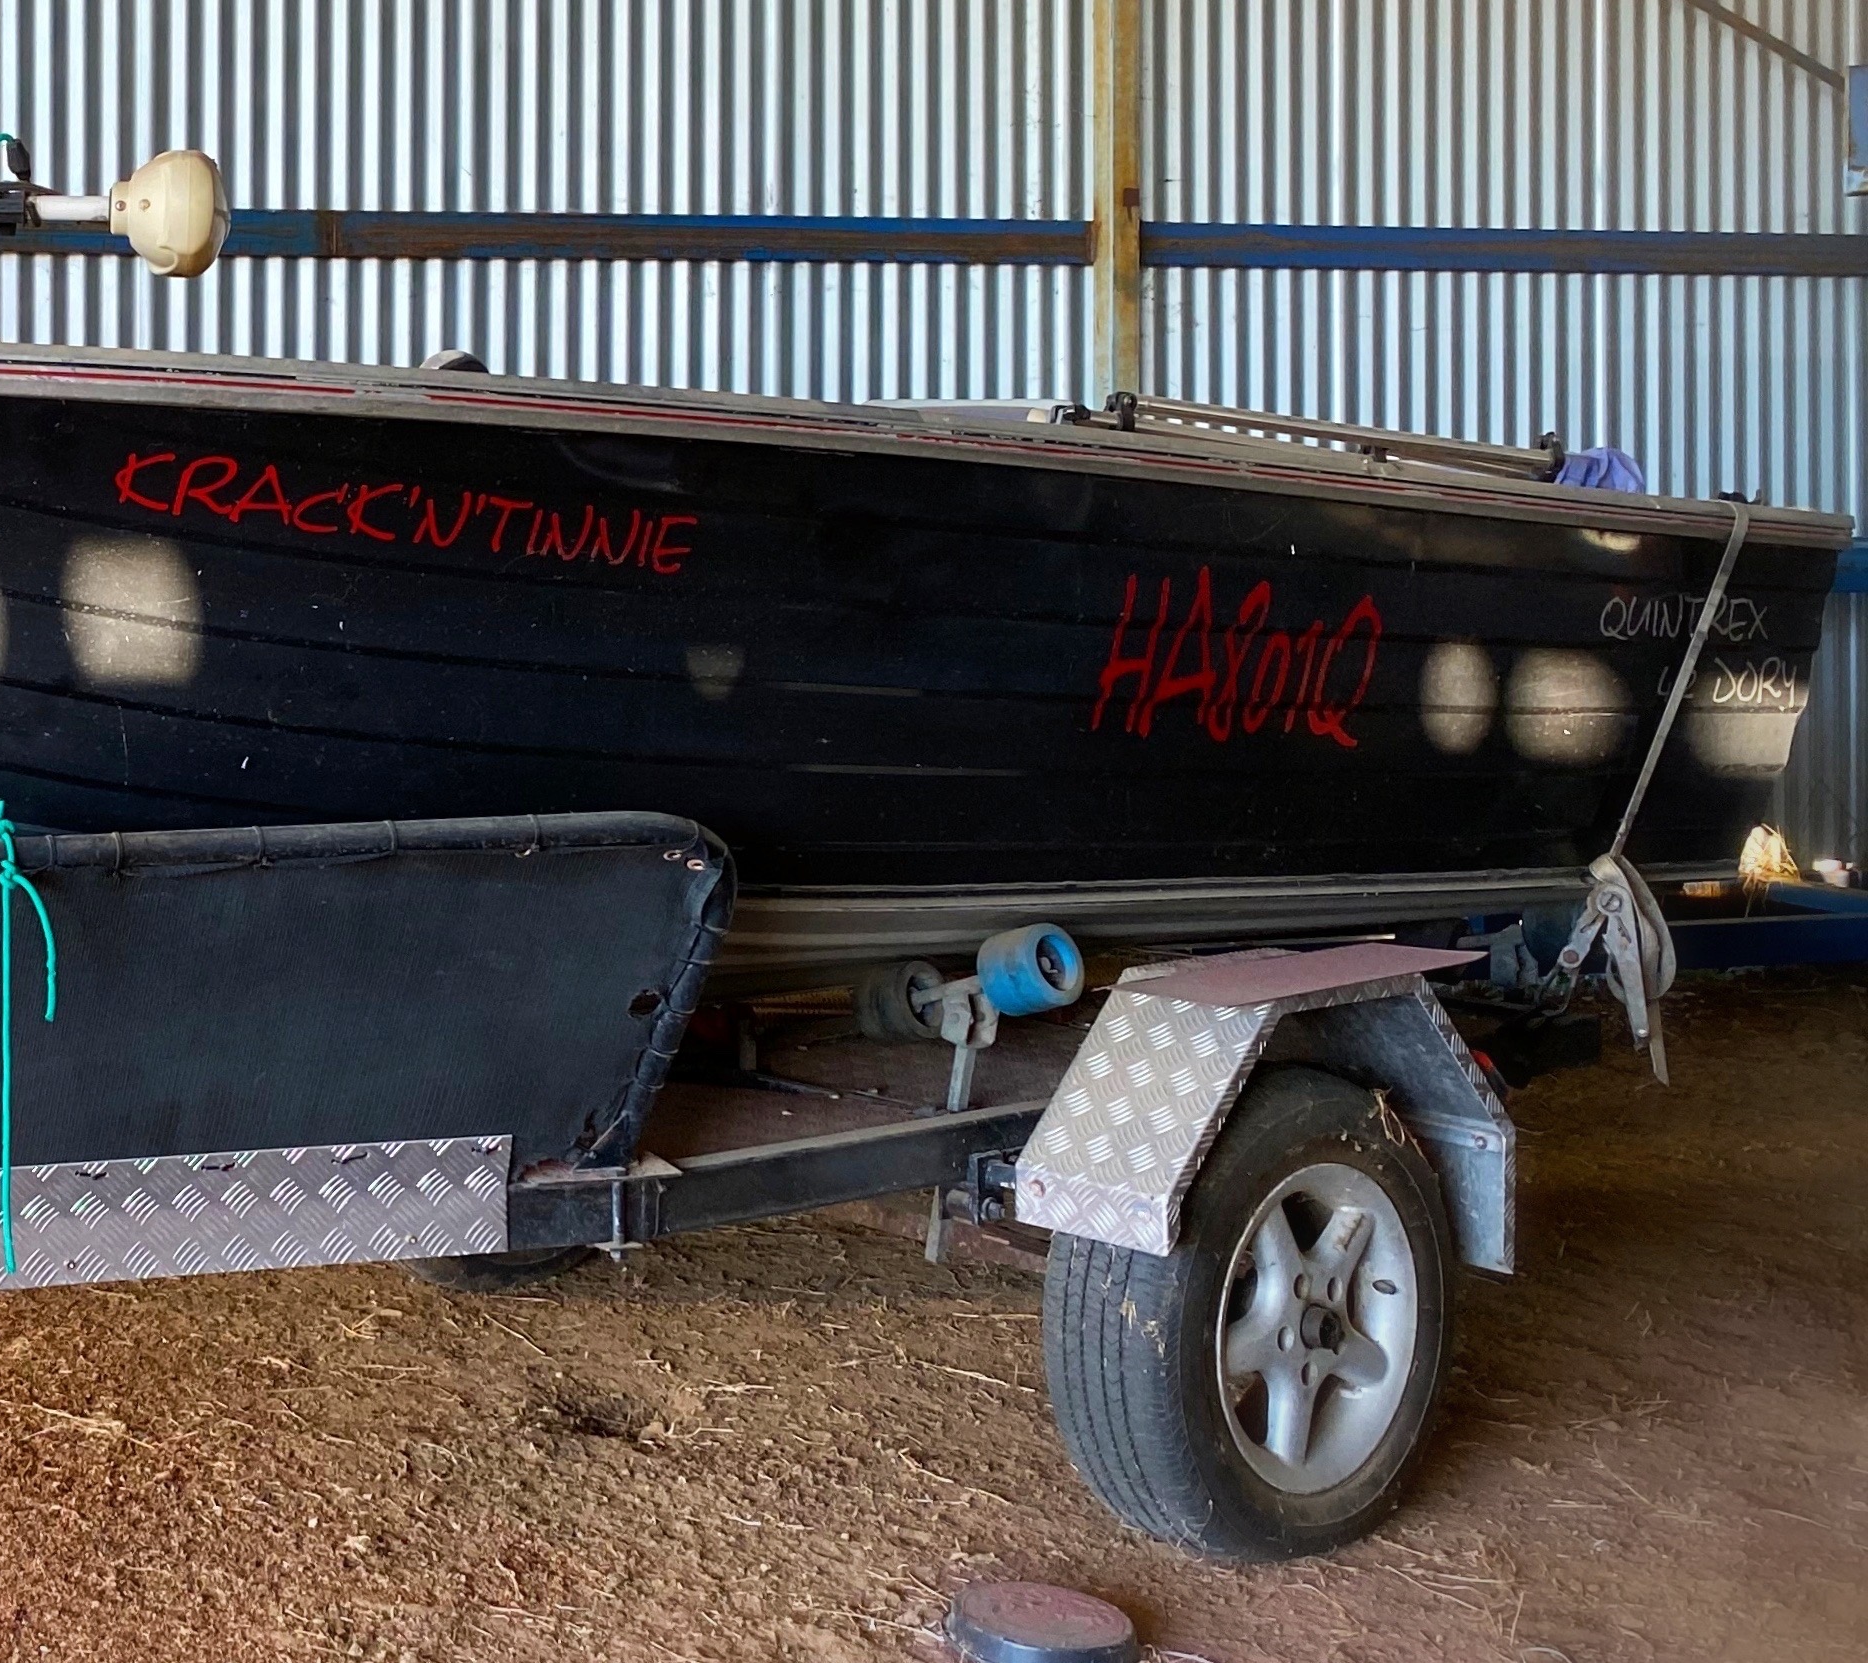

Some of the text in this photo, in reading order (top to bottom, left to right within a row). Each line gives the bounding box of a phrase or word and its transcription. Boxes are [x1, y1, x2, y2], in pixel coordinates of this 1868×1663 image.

[1599, 593, 1768, 642] QUINTREX
[1091, 565, 1382, 747] HA801Q
[1712, 656, 1797, 708] DORY
